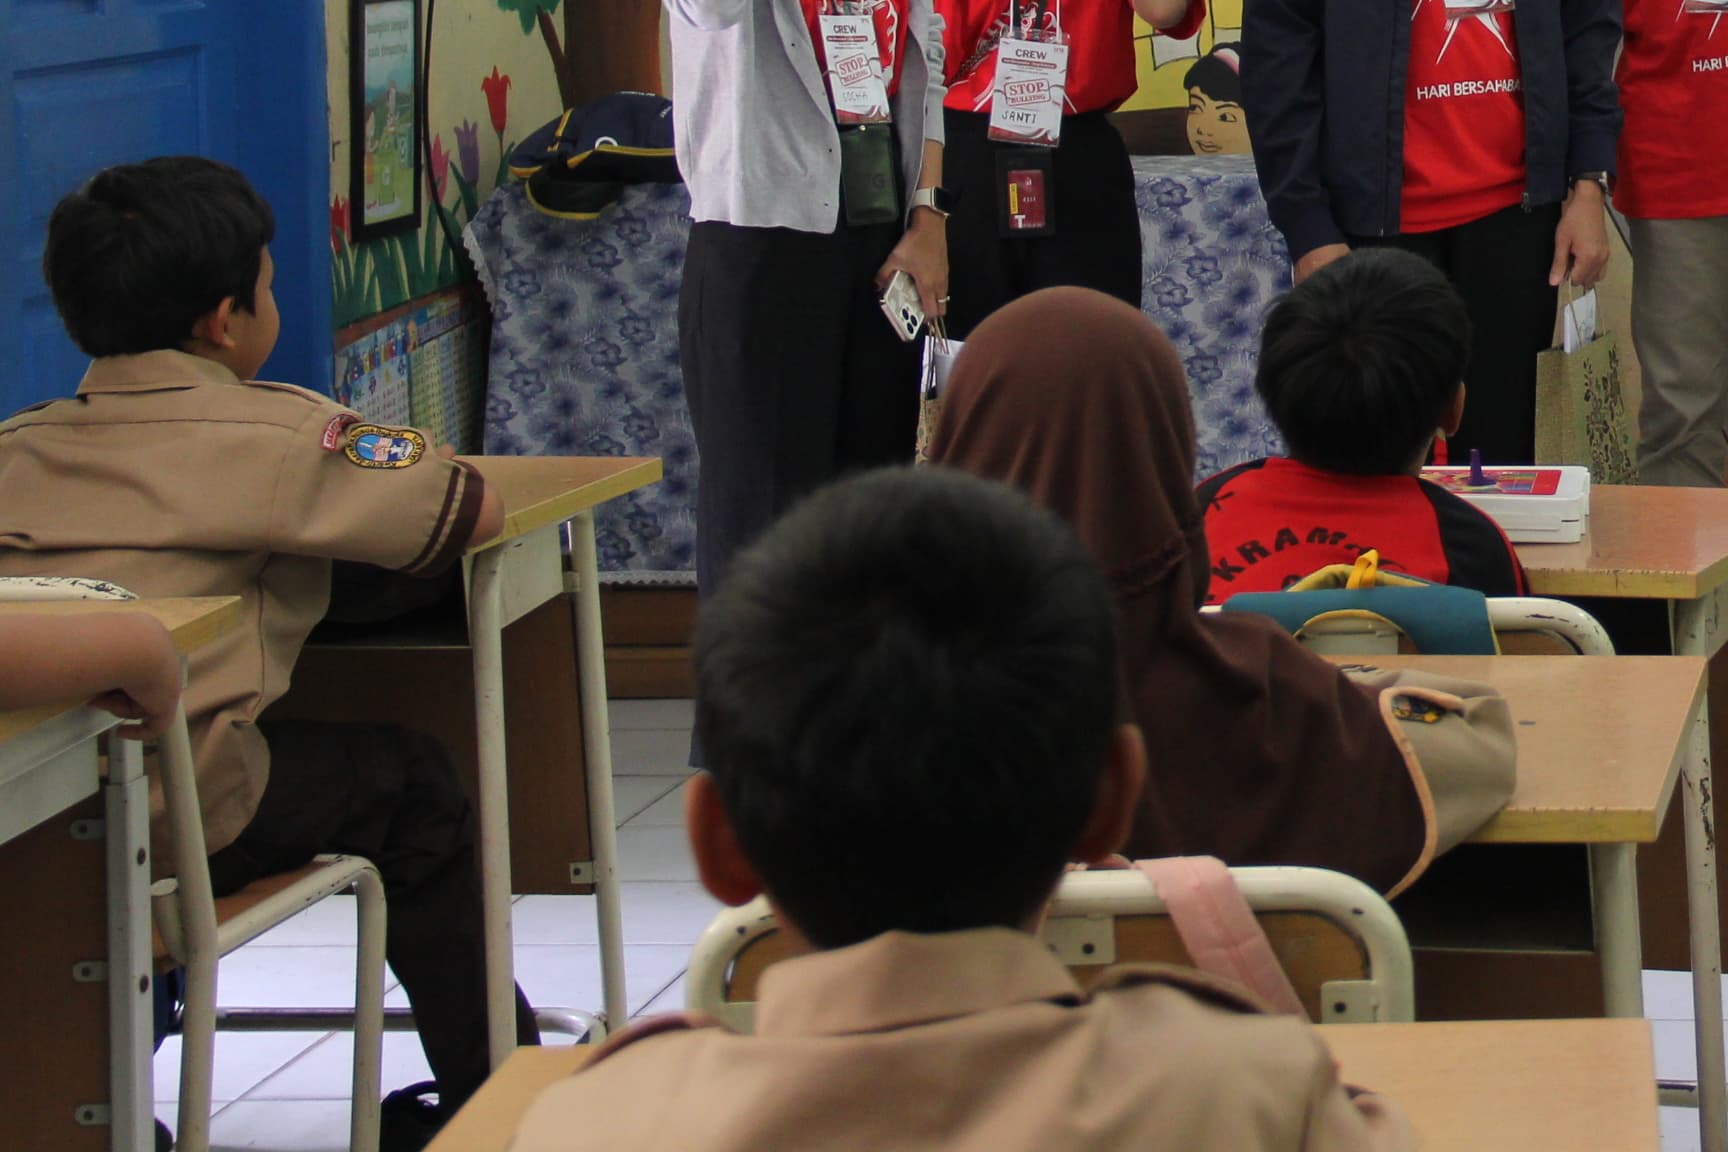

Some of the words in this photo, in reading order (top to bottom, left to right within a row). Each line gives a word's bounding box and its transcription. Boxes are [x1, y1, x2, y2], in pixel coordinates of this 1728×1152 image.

[833, 25, 857, 34] CREW
[1015, 48, 1047, 60] CREW
[839, 57, 864, 75] STOP
[1692, 57, 1722, 73] HARI
[1009, 82, 1044, 96] STOP
[1417, 83, 1451, 101] HARI
[1454, 79, 1521, 96] BERSAHABA
[1002, 110, 1036, 124] SANTI
